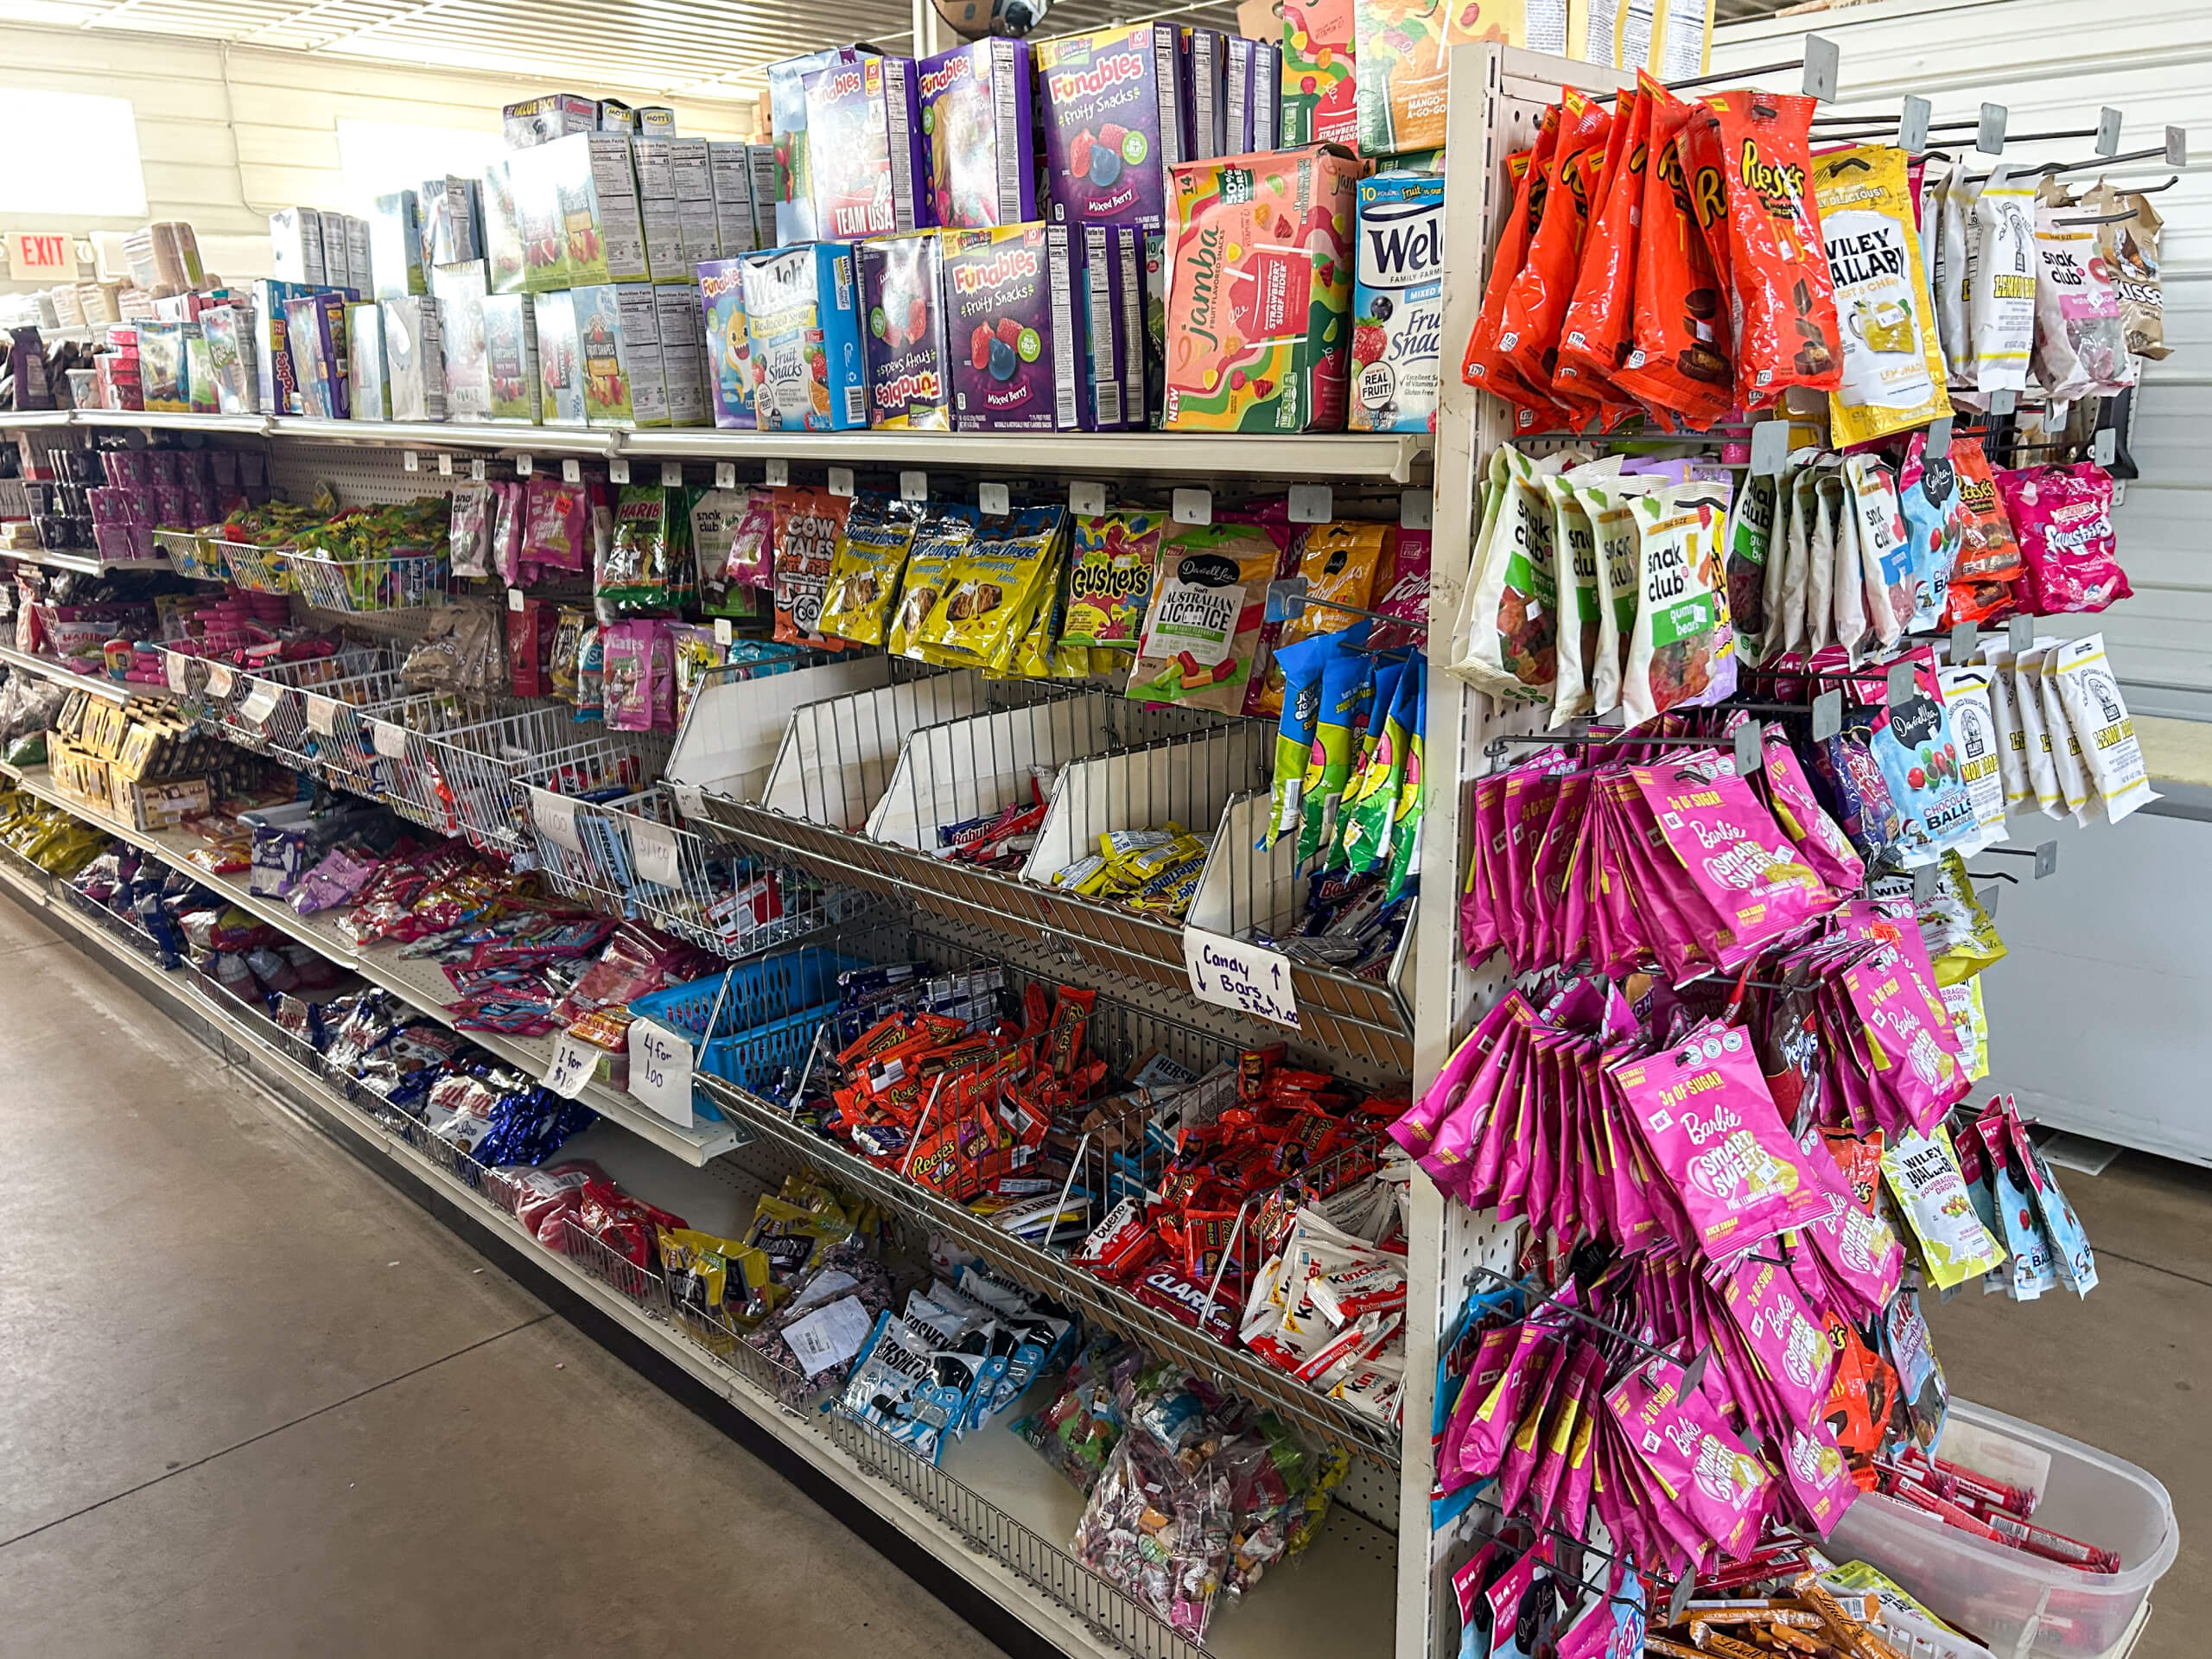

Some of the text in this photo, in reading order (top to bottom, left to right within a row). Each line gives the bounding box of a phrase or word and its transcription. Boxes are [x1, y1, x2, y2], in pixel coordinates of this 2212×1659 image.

[1133, 32, 1142, 43] 10
[920, 55, 969, 95] Funables
[1050, 54, 1144, 104] Funables
[1097, 89, 1134, 113] Snacks
[1407, 105, 1446, 119] A-GO-GO
[1408, 96, 1444, 110] MANGO-
[1741, 138, 1805, 199] Reese's
[1181, 176, 1193, 195] 14
[1225, 169, 1237, 205] 50%
[1088, 189, 1132, 213] Mixed Berry
[836, 203, 893, 235] TEAM USA
[1028, 231, 1036, 239] 10
[1147, 242, 1156, 253] 10
[1367, 218, 1444, 273] Wel
[21, 236, 65, 266] EXIT
[2042, 251, 2078, 267] snak
[748, 257, 815, 306] Welch's
[953, 251, 1037, 293] Funables
[1420, 268, 1441, 278] FARM
[1830, 246, 1905, 289] ALLABY
[2052, 266, 2082, 284] club
[995, 287, 1028, 307] Snacks
[1181, 221, 1220, 353] jamba
[1211, 260, 1224, 306] FLAVORED
[1268, 261, 1280, 329] STRAWBERRY
[1275, 263, 1287, 326] SURF RIDER
[1410, 288, 1437, 299] MIXED
[754, 310, 810, 331] Reduced Sugar
[1209, 306, 1218, 329] FRUIT
[774, 345, 798, 366] Fruit
[1021, 342, 1037, 353] FRUIT
[1388, 332, 1439, 361] Snac
[769, 360, 803, 384] Snacks
[1365, 372, 1388, 385] REAL
[875, 372, 941, 406] Funables
[987, 385, 1027, 404] Mixed Berry
[1362, 384, 1391, 397] FRUIT!
[1168, 387, 1179, 422] NEW
[619, 502, 660, 519] HARIB
[696, 510, 721, 521] snak
[1516, 498, 1551, 543] snak
[700, 520, 719, 532] club
[788, 516, 836, 538] COW
[847, 524, 909, 548] Butterfinger
[785, 537, 835, 561] TALES
[971, 538, 1042, 560] Butterfinger
[1515, 526, 1545, 565] club
[1647, 543, 1682, 574] snak
[995, 570, 1019, 585] Minis
[1071, 563, 1150, 598] Gushers
[1649, 575, 1684, 603] club
[1163, 591, 1236, 614] AUSTRALIAN
[61, 632, 109, 644] HARIBO
[1675, 618, 1699, 637] bears
[1667, 791, 1721, 812] 3g OF SUGAR
[1926, 800, 1973, 830] BALLS
[1690, 820, 1746, 849] Barbie
[1713, 842, 1761, 877] SMART
[1727, 852, 1780, 889] SWEETS
[1201, 944, 1250, 982] Candy
[1220, 972, 1262, 999] Bars
[1239, 994, 1300, 1025] 3 for $1.00
[1888, 1006, 1921, 1039] Barbie
[1058, 1001, 1084, 1052] Reese's
[567, 1051, 582, 1070] for
[644, 1033, 672, 1061] 4 for
[645, 1064, 664, 1087] 1.00
[967, 1074, 995, 1096] Reese's
[1659, 1071, 1724, 1106] 3g OF SUGAR
[889, 1082, 920, 1107] Rees
[1307, 1117, 1334, 1151] Reese's
[1680, 1104, 1742, 1145] Barbie
[911, 1140, 956, 1177] Reese's
[1700, 1129, 1752, 1175] SMART
[1903, 1145, 1944, 1169] WILEY
[1713, 1144, 1770, 1198] SWEETS
[1906, 1157, 1955, 1189] WALLABY
[1935, 1182, 1958, 1195] DROPS
[1091, 1203, 1128, 1240] bueno
[1841, 1206, 1862, 1252] SMART
[756, 1236, 806, 1257] HERSHEY'S
[1328, 1262, 1389, 1284] kinder
[1347, 1271, 1379, 1285] CHOCOLATE
[1144, 1273, 1230, 1319] CLARK
[1211, 1317, 1232, 1331] CUPS
[1764, 1290, 1796, 1339] Barbie
[1785, 1312, 1808, 1358] SMART
[1640, 1381, 1675, 1427] 3g OF SUGAR
[1664, 1415, 1700, 1457] Barbie
[1694, 1433, 1721, 1483] SMART
[1707, 1443, 1738, 1501] SWEETS
[1816, 1593, 1856, 1629] Lindt
[1715, 1636, 1764, 1659] Lindt
